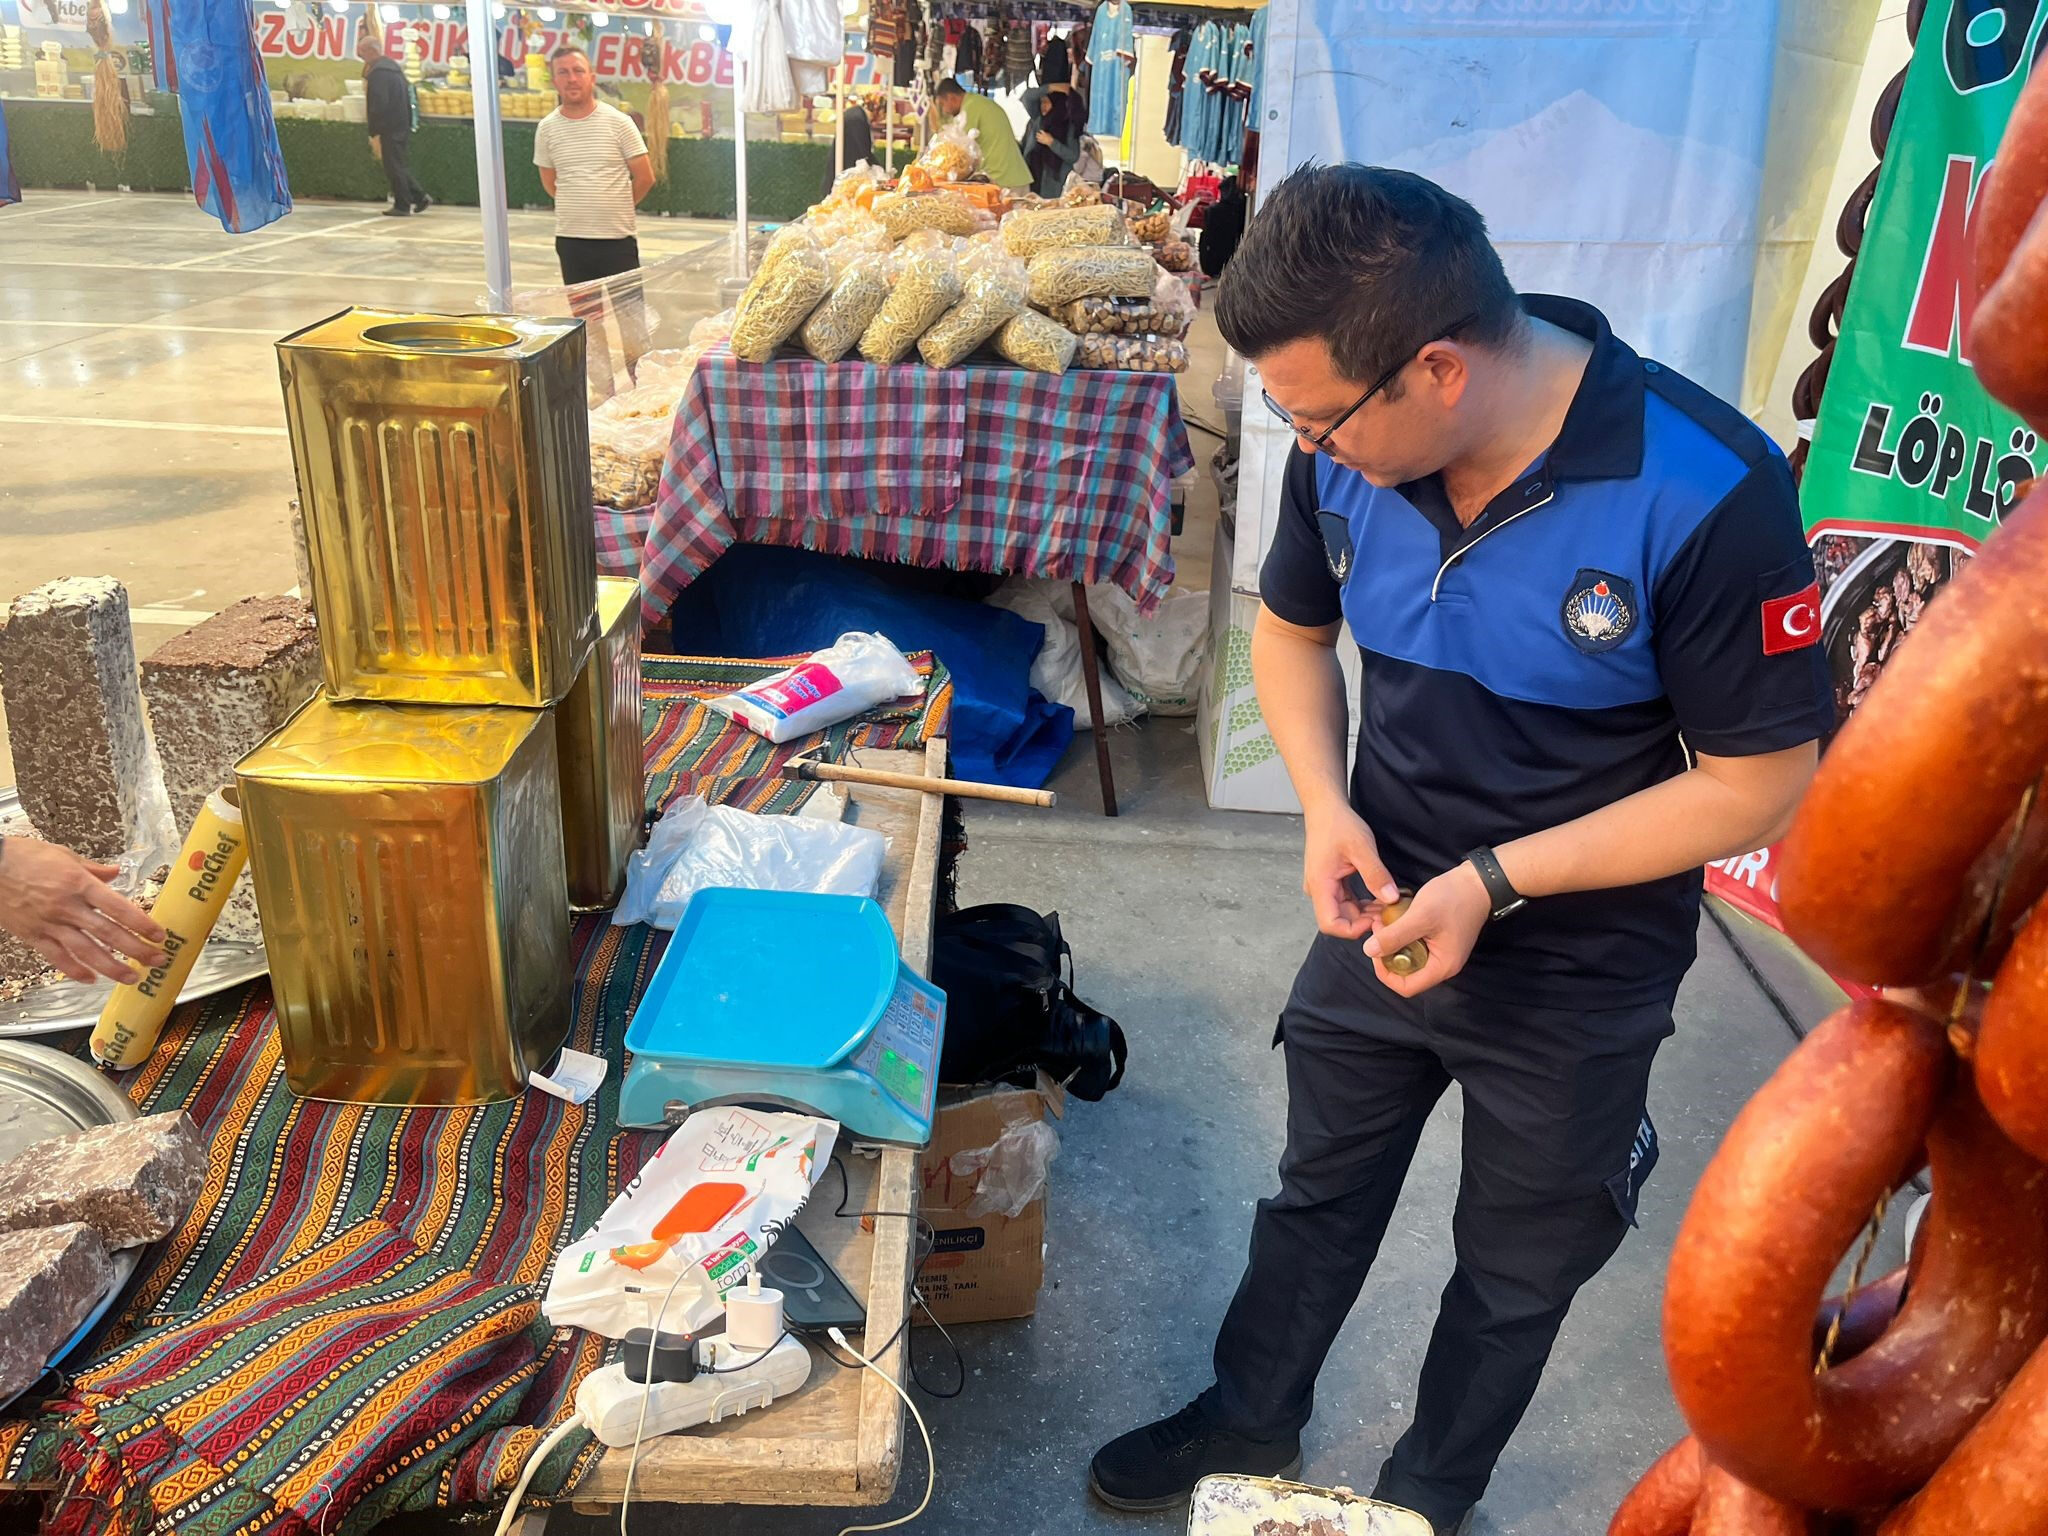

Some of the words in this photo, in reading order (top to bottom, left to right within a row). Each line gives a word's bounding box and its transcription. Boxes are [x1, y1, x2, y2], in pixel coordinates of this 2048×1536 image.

[1850, 391, 1966, 499] LÖP
[1963, 427, 2048, 528] LÖ
[188, 831, 241, 902] ProChef
